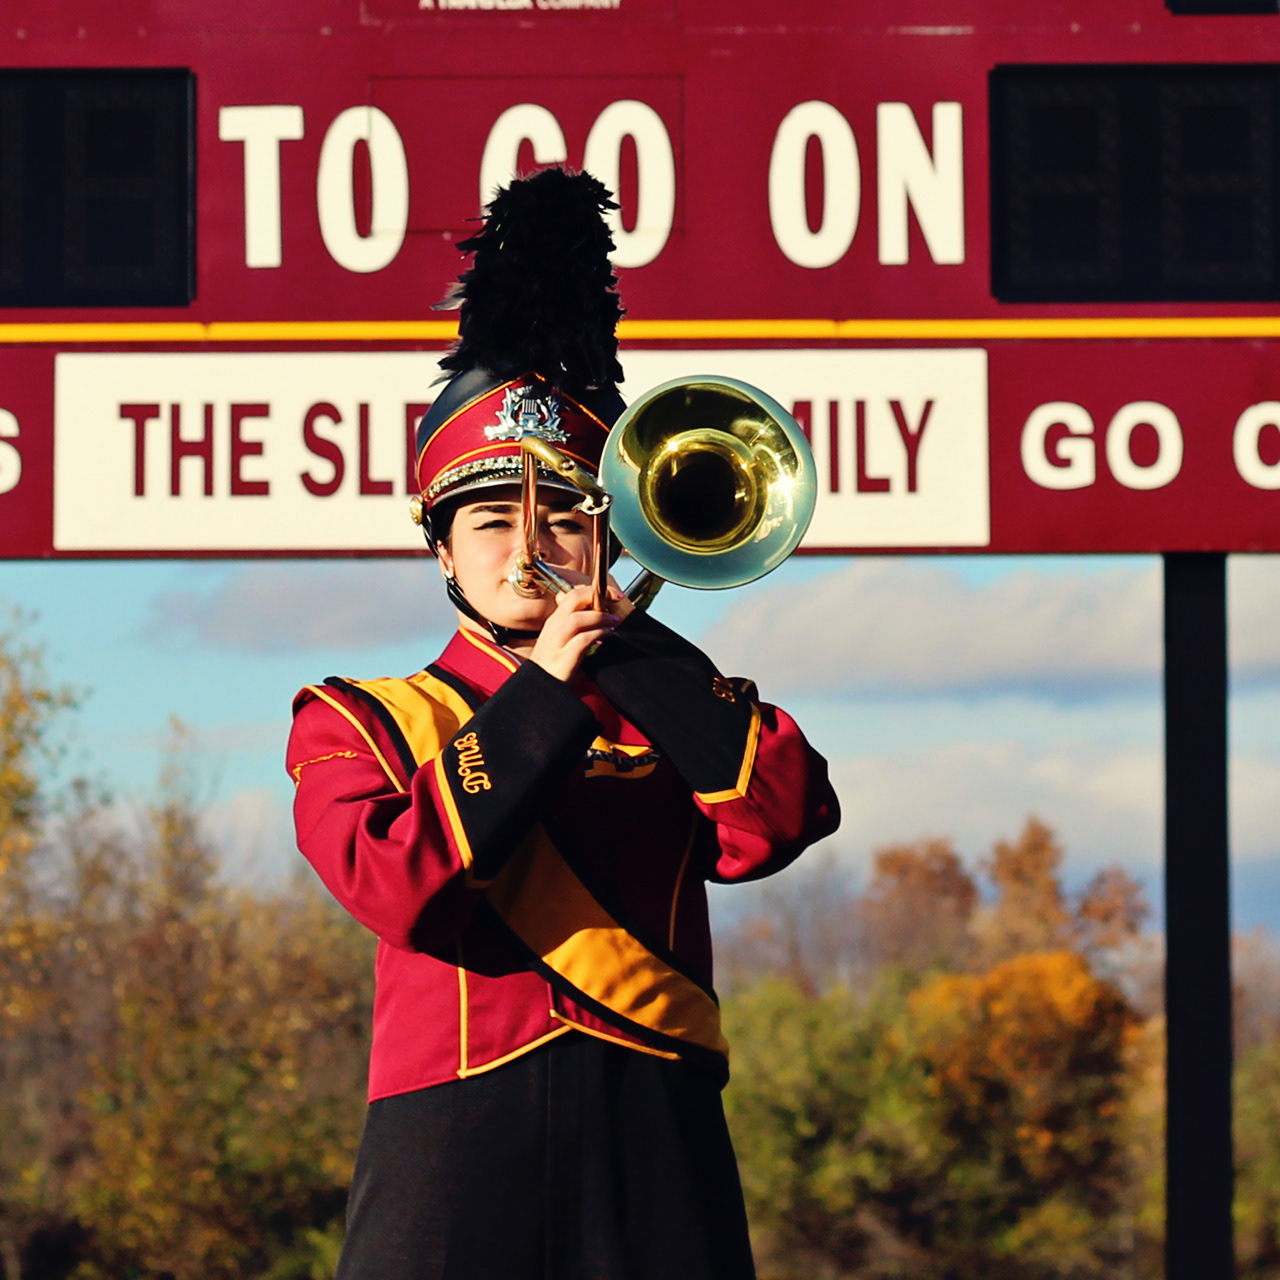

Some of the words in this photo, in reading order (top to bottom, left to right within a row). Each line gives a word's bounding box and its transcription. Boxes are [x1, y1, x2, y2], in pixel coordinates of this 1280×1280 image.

[219, 105, 409, 273] TO
[768, 100, 965, 268] ON
[119, 402, 270, 497] THE
[1021, 401, 1183, 490] GO
